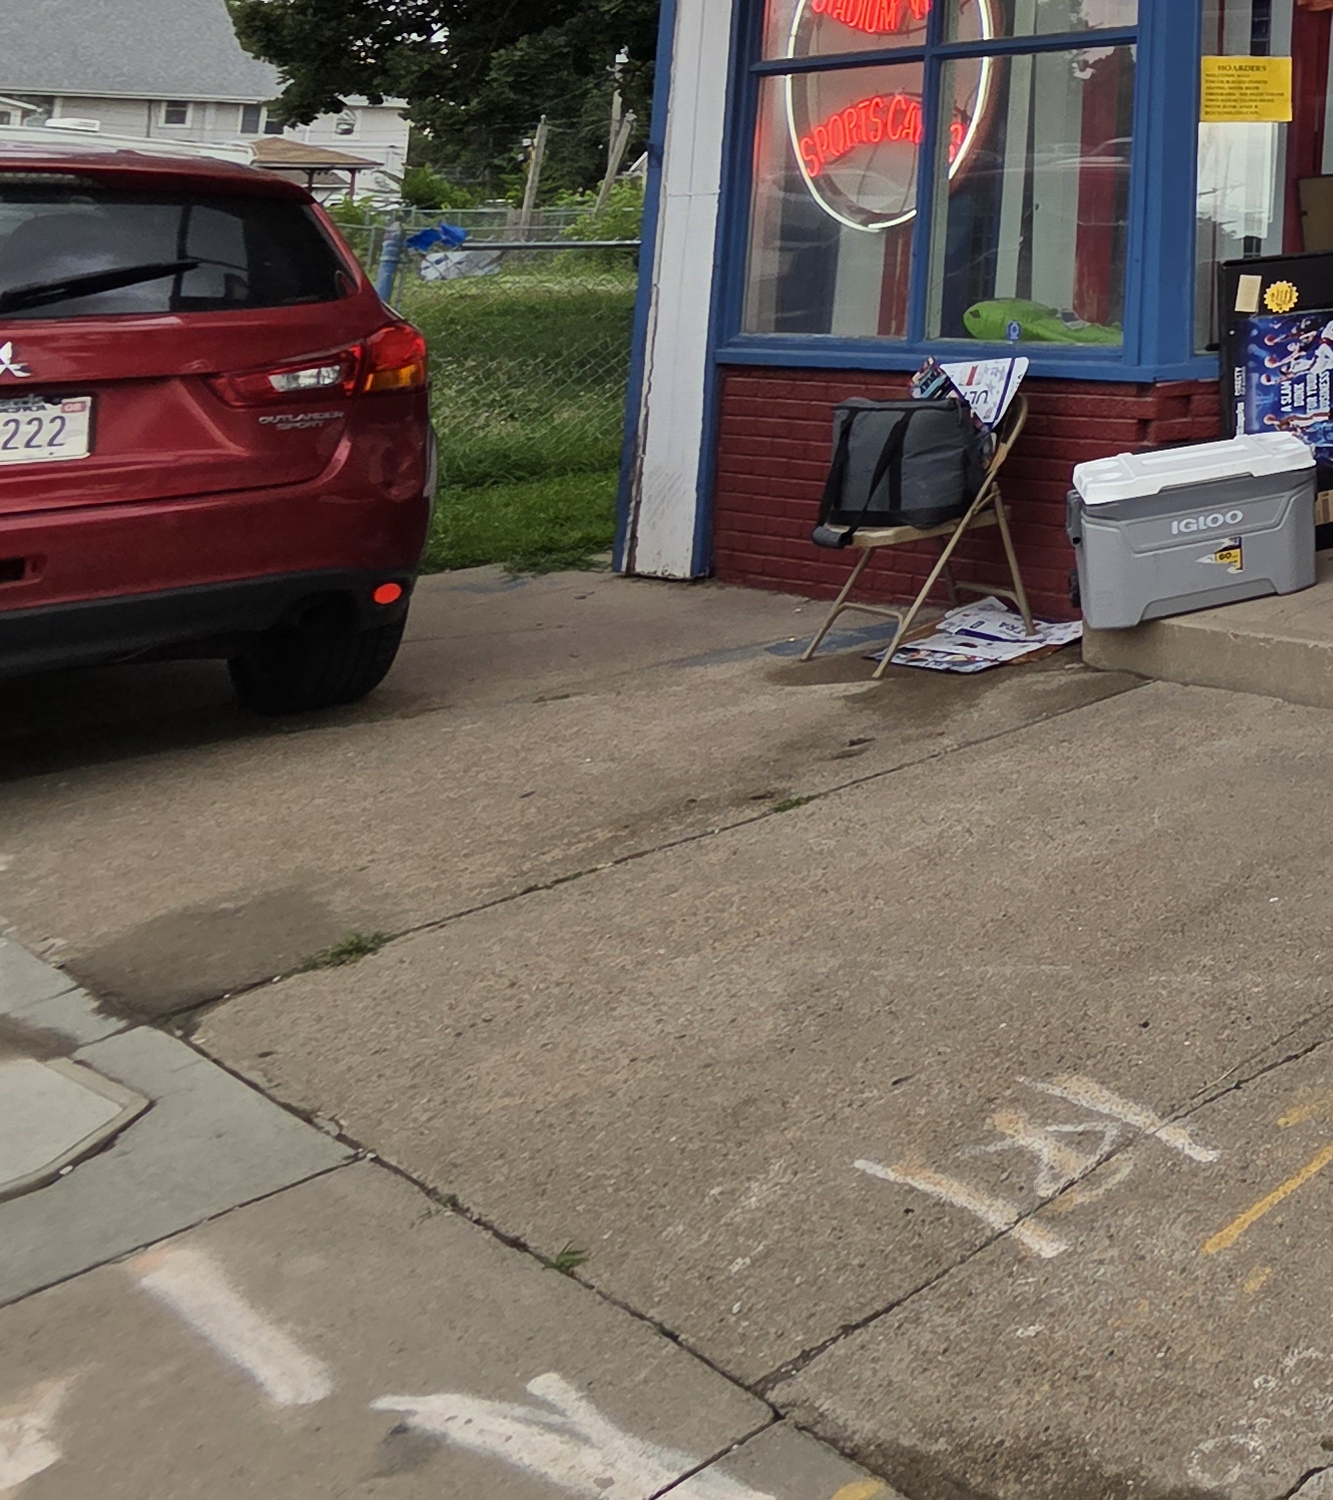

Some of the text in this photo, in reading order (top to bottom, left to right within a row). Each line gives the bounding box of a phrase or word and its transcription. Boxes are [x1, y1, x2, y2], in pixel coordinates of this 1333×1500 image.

[800, 97, 885, 178] SPORTS
[1281, 381, 1292, 404] SLAM
[1, 415, 66, 451] 222
[1171, 510, 1243, 535] IGLOO
